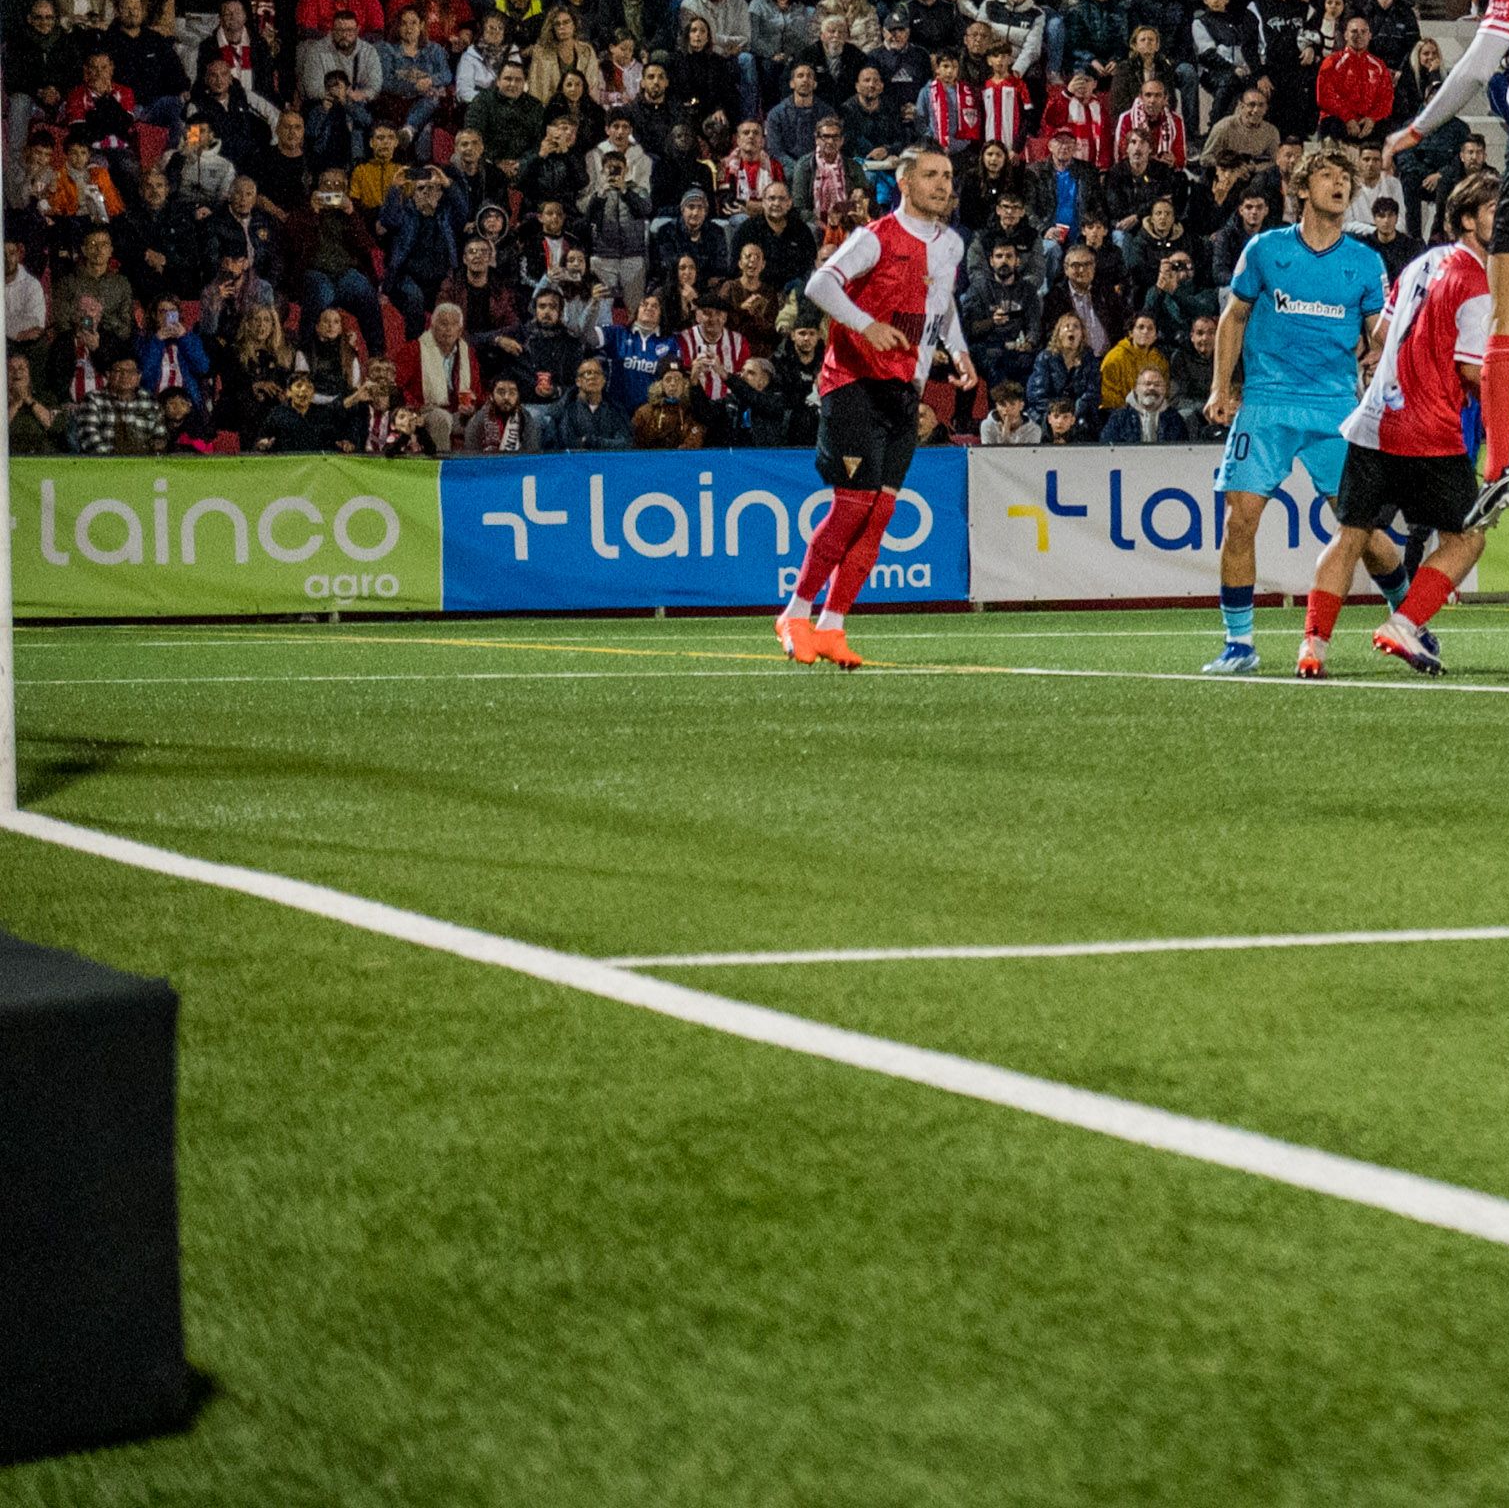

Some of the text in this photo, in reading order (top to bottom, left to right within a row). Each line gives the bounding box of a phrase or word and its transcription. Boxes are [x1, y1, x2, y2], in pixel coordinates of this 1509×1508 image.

[40, 478, 400, 567] lainco
[304, 572, 400, 608] agro
[778, 563, 932, 598] pma
